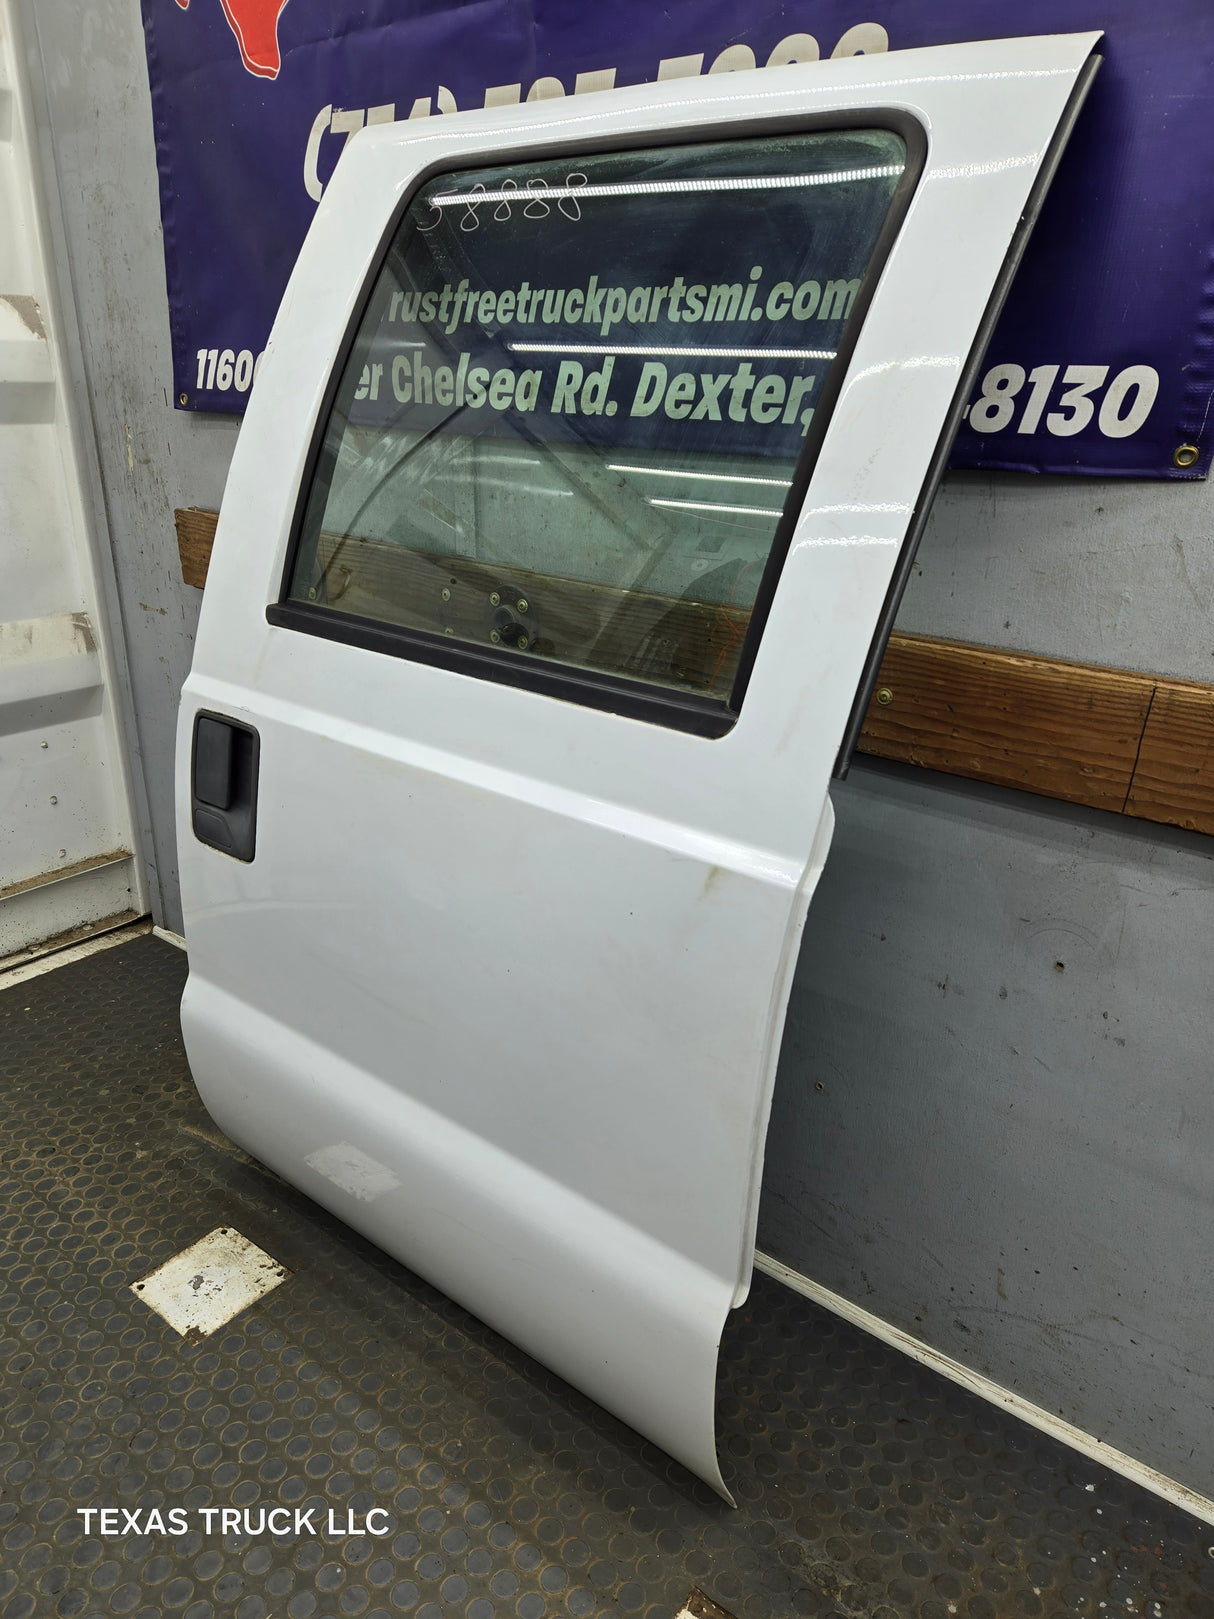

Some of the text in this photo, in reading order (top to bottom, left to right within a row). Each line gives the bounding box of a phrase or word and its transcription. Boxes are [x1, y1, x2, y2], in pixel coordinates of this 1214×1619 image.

[388, 265, 862, 336] rustfreetruckpartsmi.com
[391, 350, 543, 412] Chelsea
[550, 355, 619, 418] Rd.
[629, 361, 816, 437] Dexter,
[962, 363, 1160, 439] 8130
